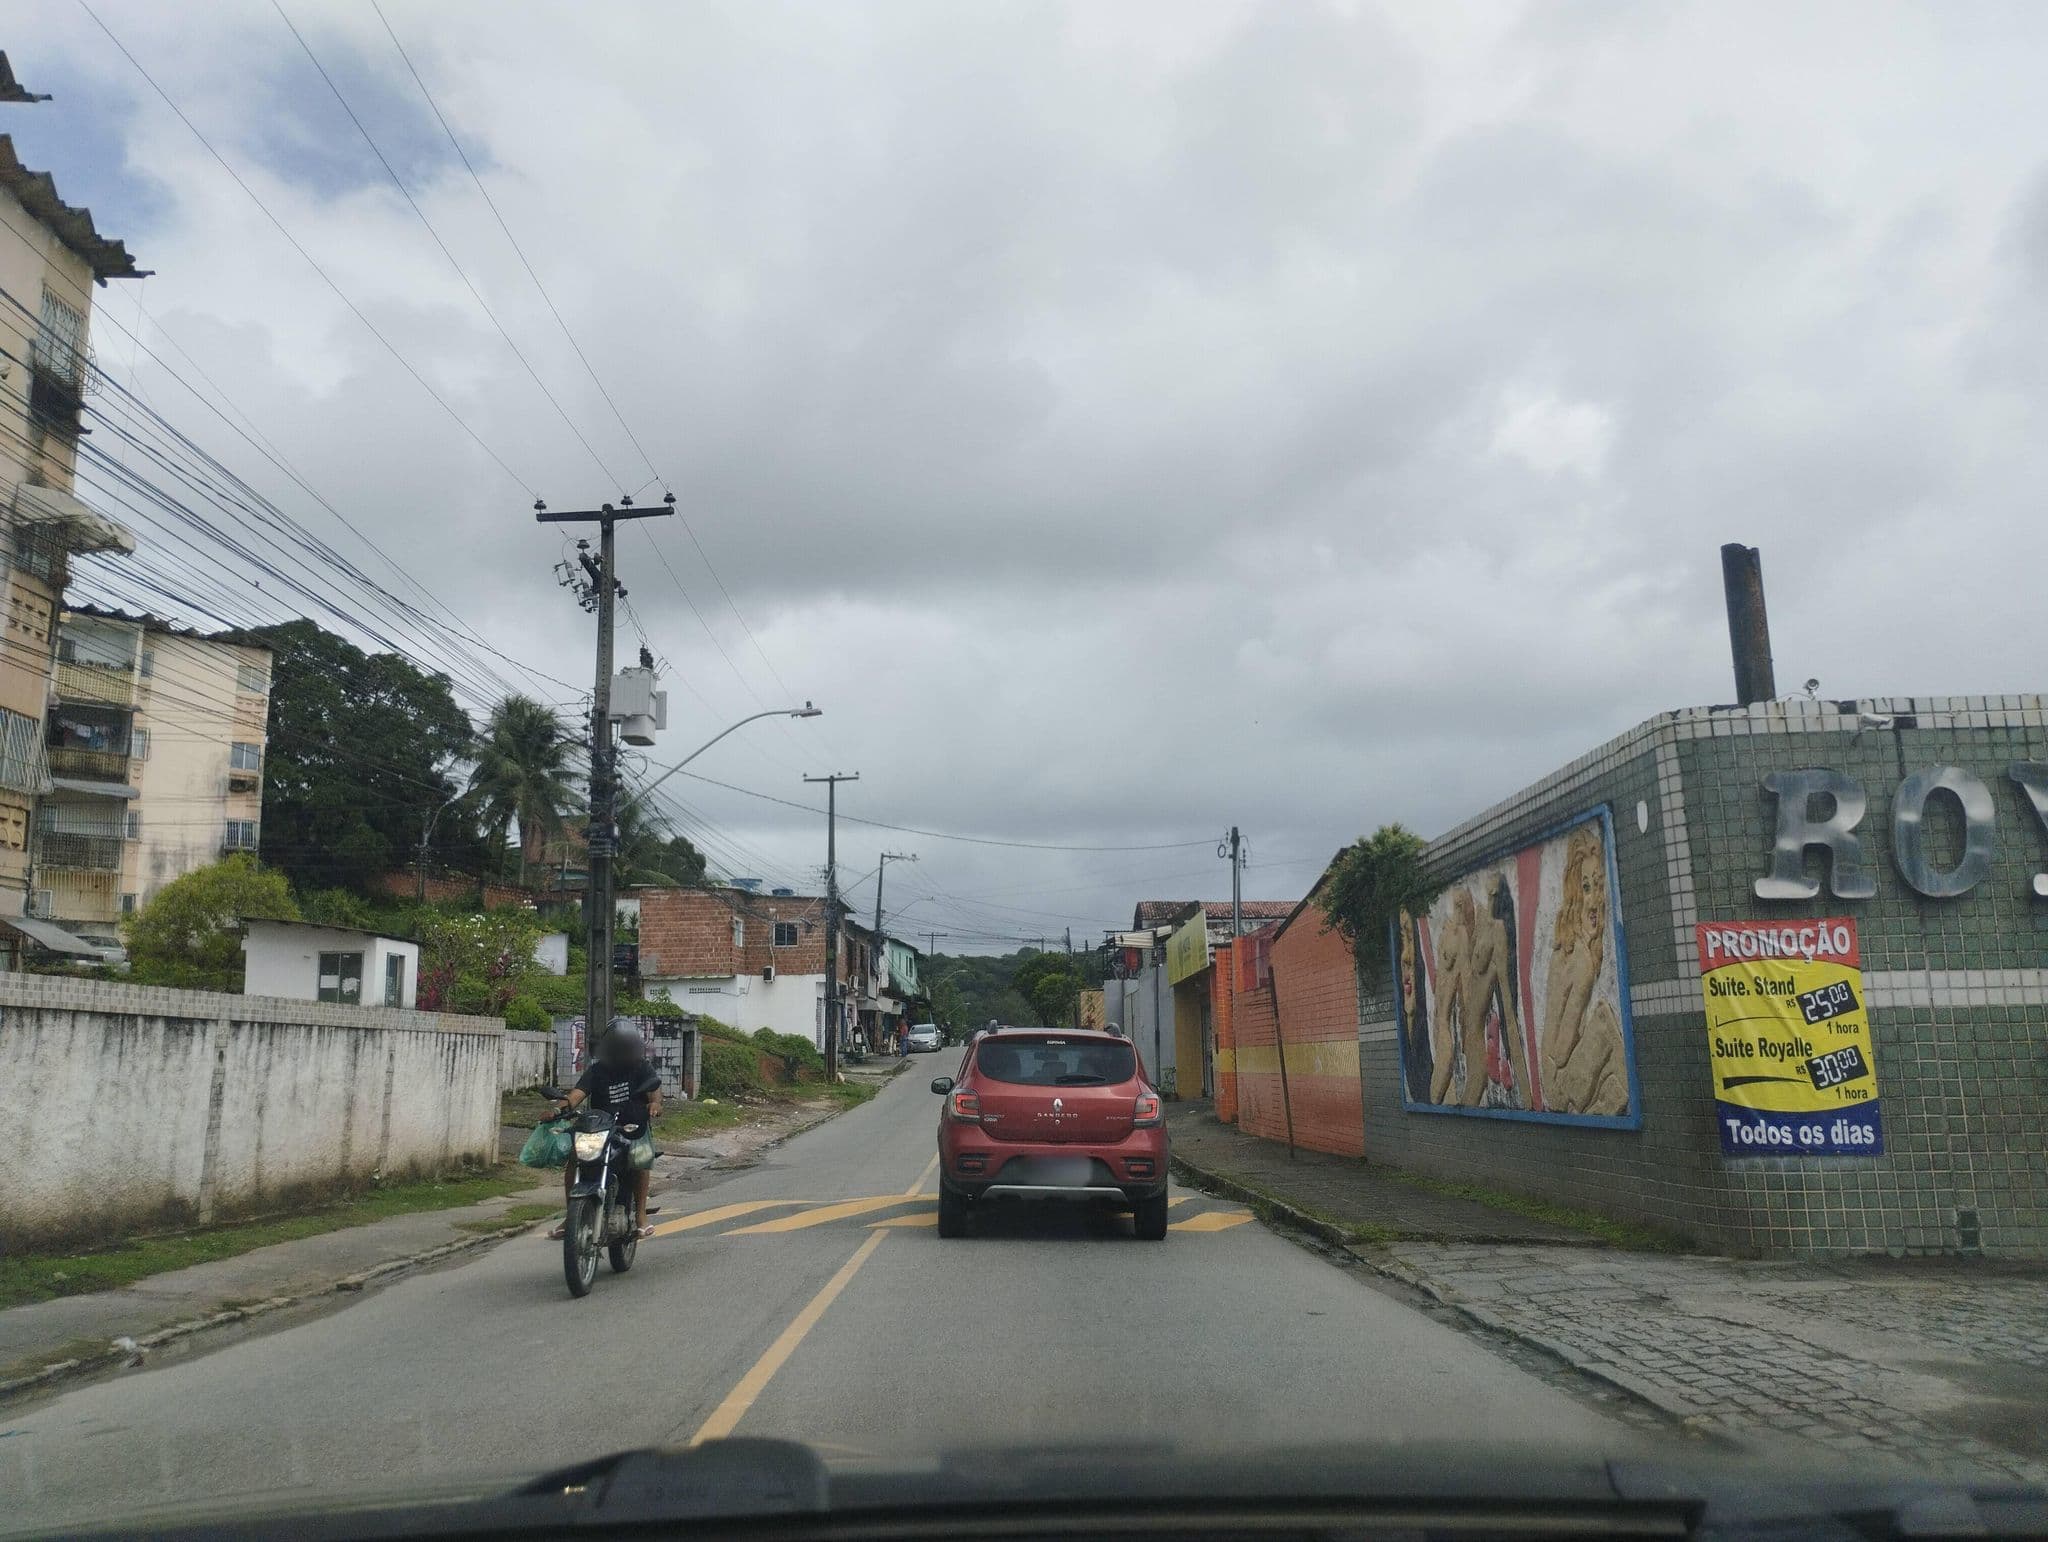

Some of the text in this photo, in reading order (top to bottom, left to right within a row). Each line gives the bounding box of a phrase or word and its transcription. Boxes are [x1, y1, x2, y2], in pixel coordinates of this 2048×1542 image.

[1705, 921, 1851, 964] PROMOÇÃO
[1754, 976, 1796, 997] Stand
[1827, 1021, 1860, 1034] 1 hora
[1715, 1037, 1813, 1063] Suite Royalle
[1835, 1087, 1868, 1099] 1 hora
[1726, 1119, 1875, 1145] Todos os dias
